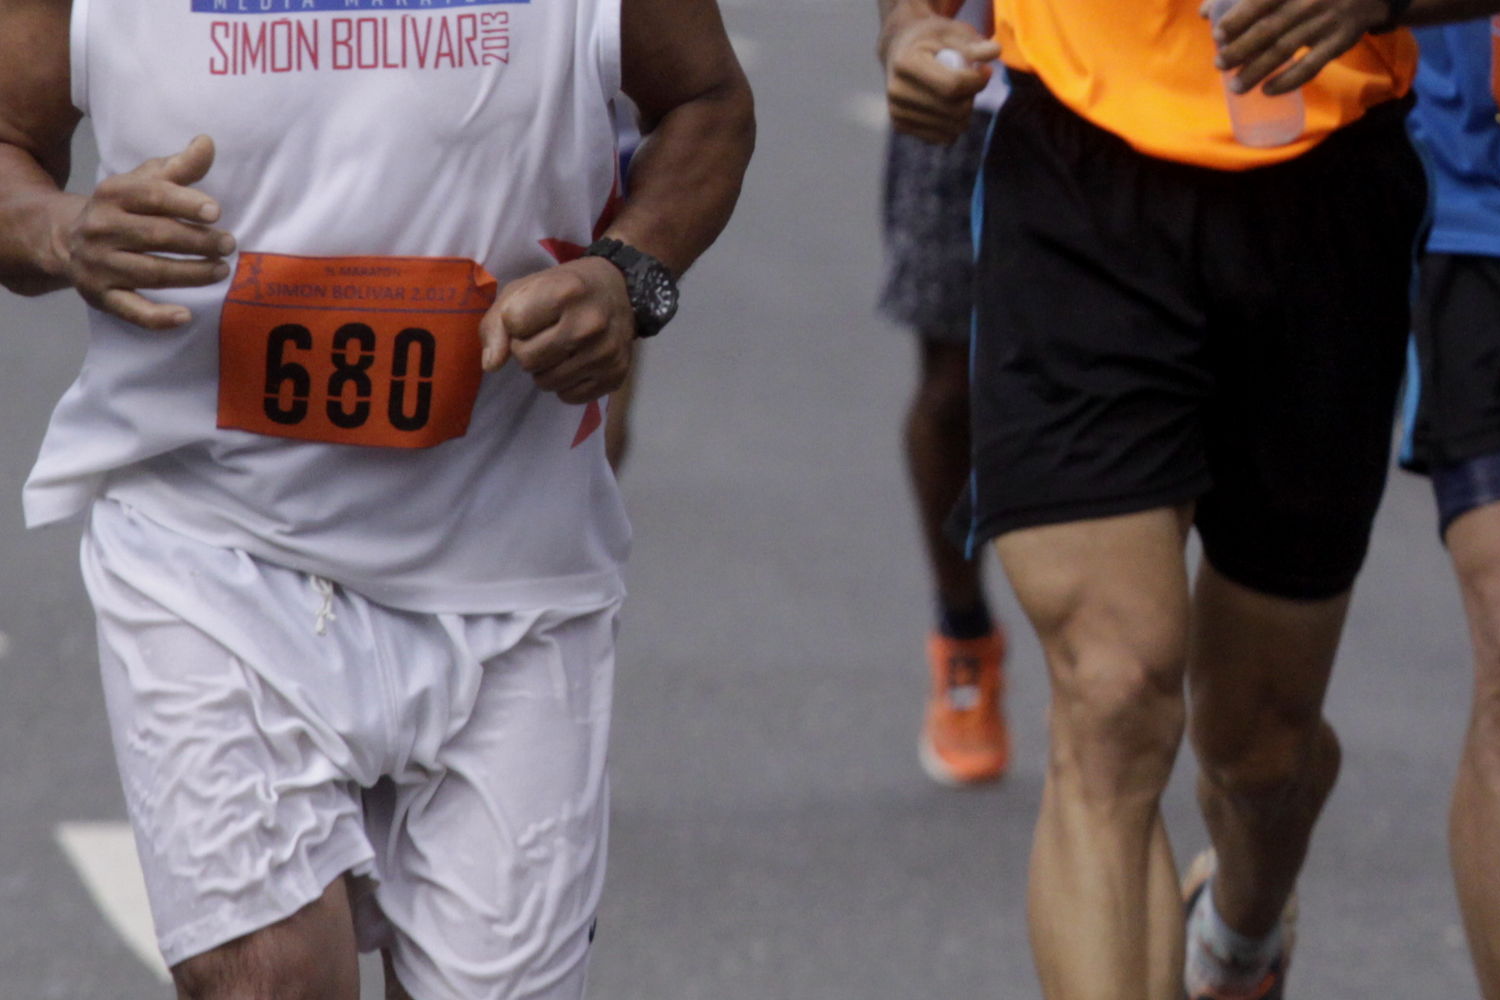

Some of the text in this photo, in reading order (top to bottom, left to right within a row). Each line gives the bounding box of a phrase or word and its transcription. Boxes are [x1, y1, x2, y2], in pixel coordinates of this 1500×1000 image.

[209, 13, 479, 76] SIMÓN BOLÍVAR
[481, 10, 510, 66] 2013
[267, 283, 326, 299] SIMON
[332, 285, 405, 300] BOLIVAR
[263, 322, 437, 432] 680
